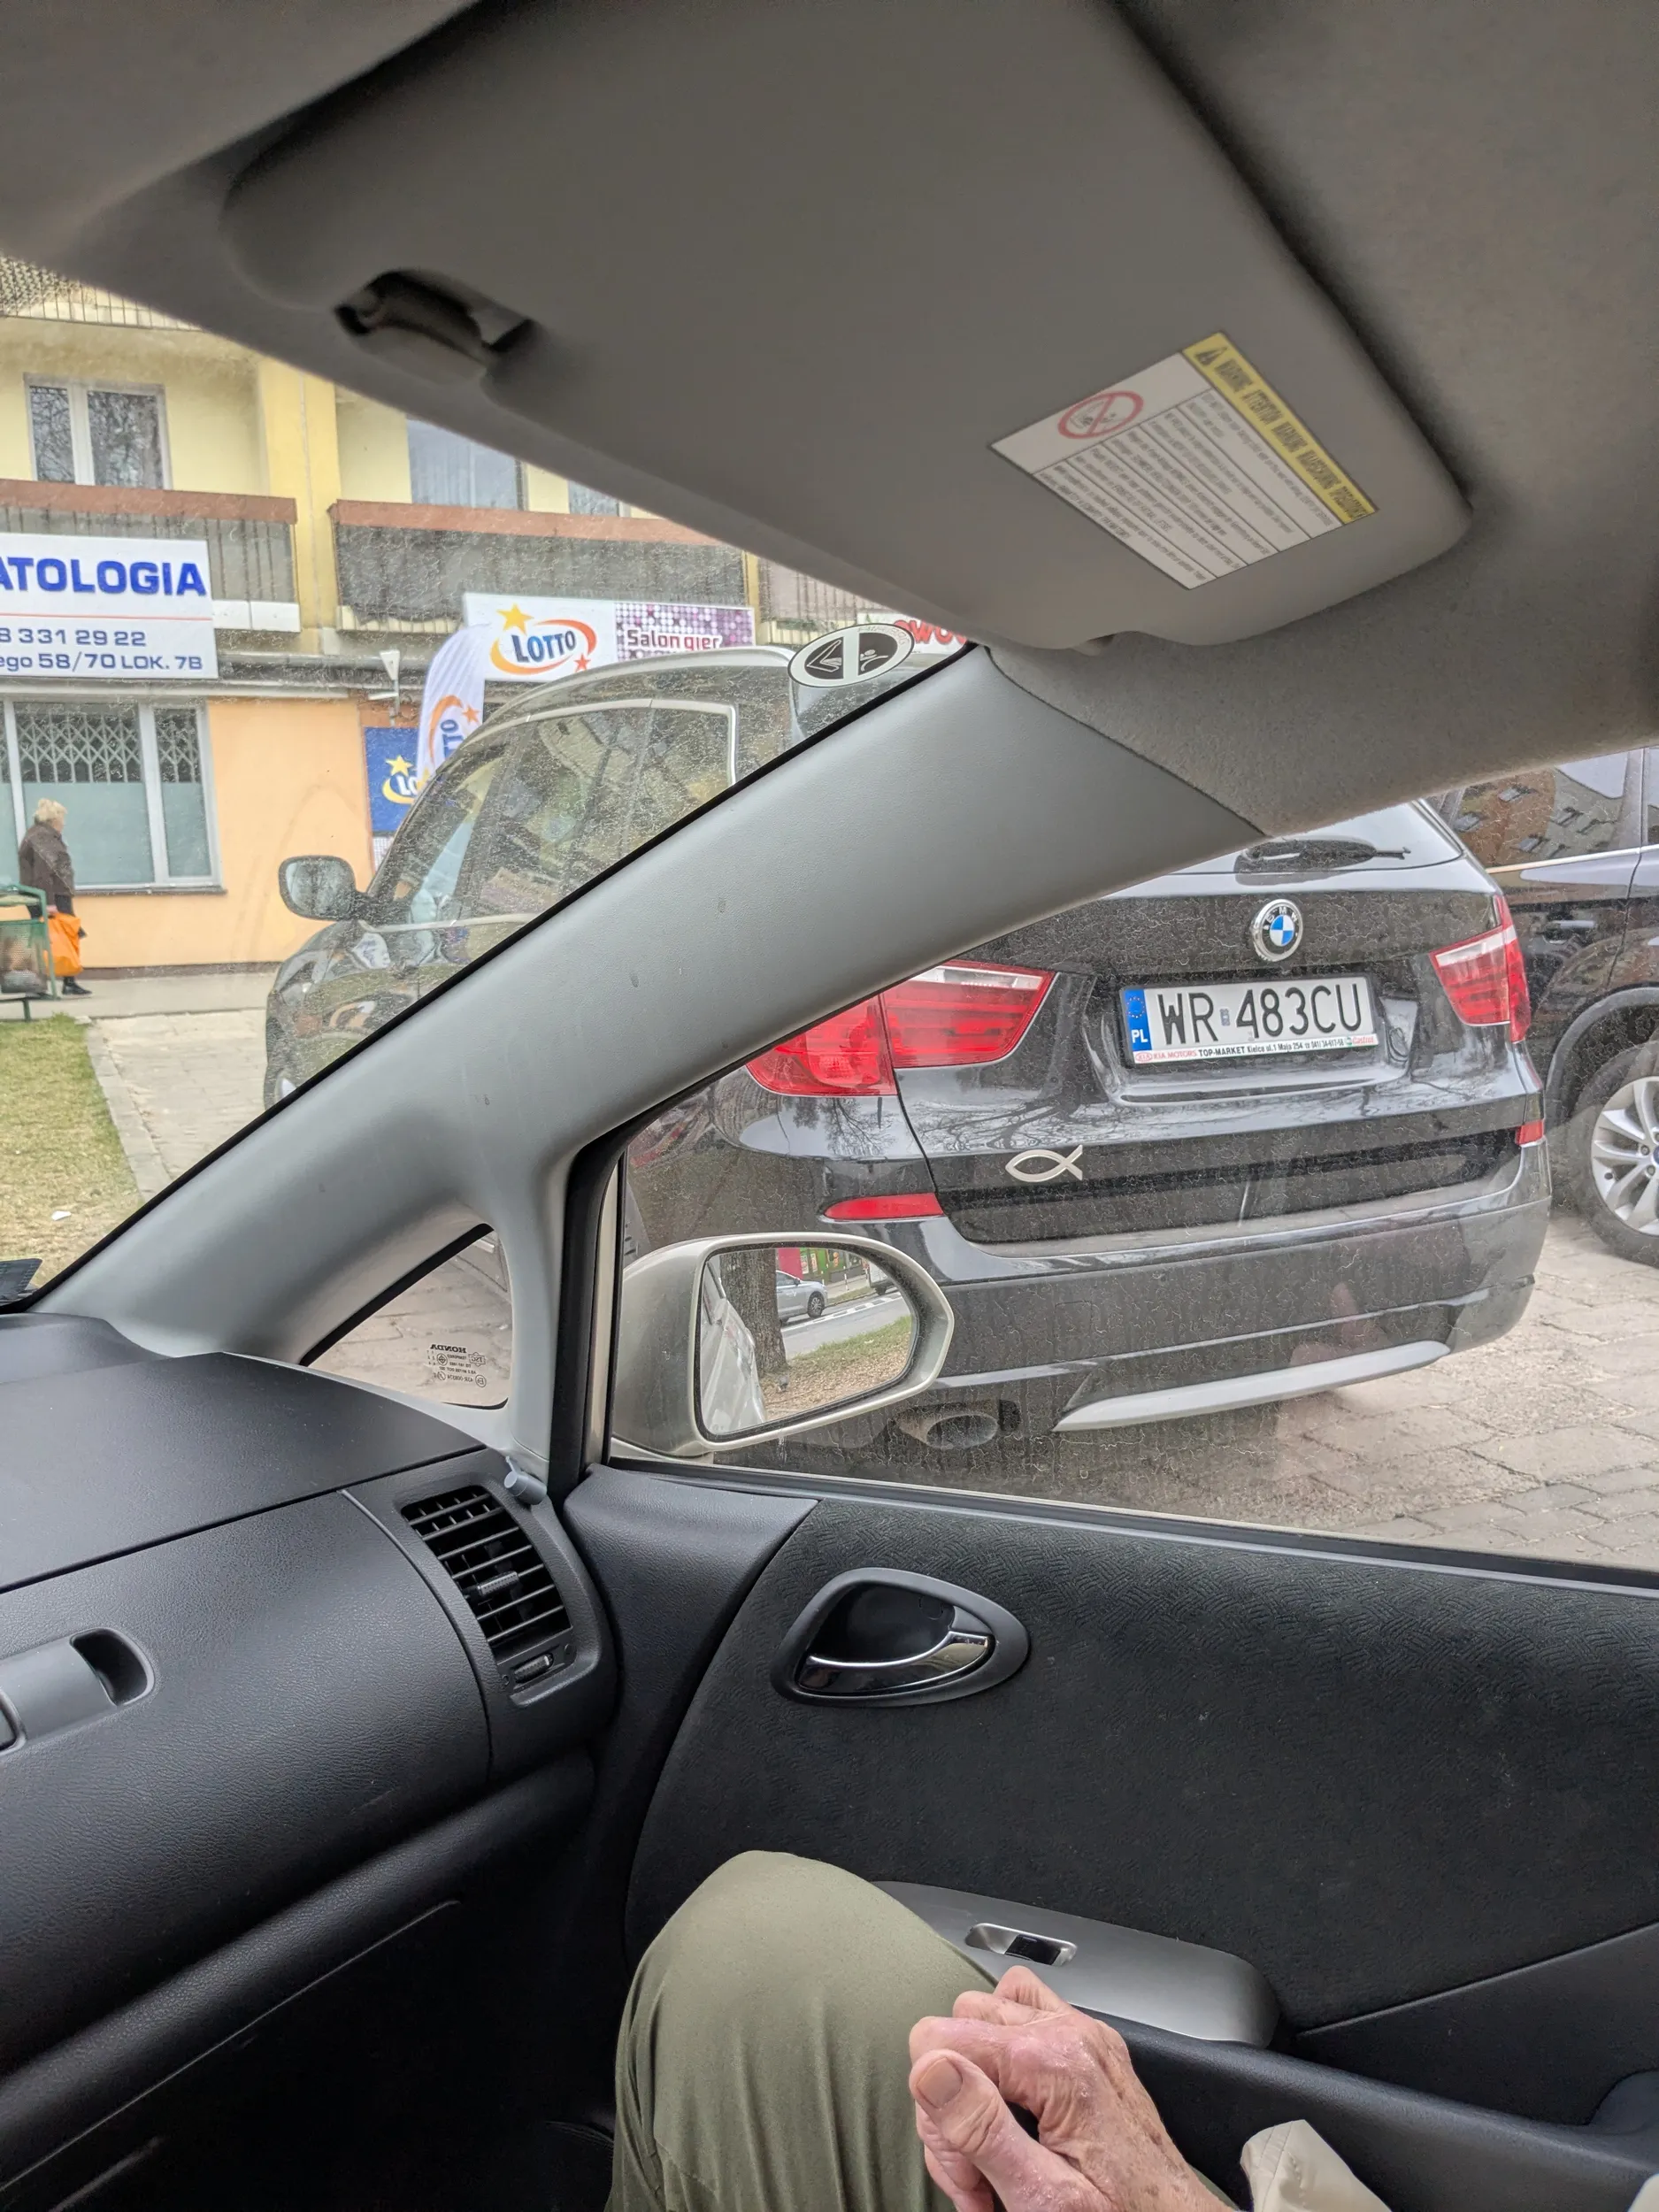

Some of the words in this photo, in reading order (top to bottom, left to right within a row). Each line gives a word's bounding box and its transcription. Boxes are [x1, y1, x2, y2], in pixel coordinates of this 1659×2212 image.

[18, 628, 66, 644] 331
[75, 630, 108, 645] 29
[114, 631, 146, 647] 22
[511, 630, 577, 664] LOTTO
[627, 629, 680, 649] Salon
[684, 635, 719, 651] gier
[38, 651, 116, 672] 58/70
[121, 656, 170, 670] LOK.
[1157, 992, 1218, 1045] WR
[1235, 983, 1362, 1040] 483CU
[1132, 1029, 1148, 1043] PL
[1168, 1050, 1197, 1059] MOTORS
[1198, 1047, 1245, 1056] TOP-MARKET
[1279, 1043, 1293, 1052] Maja
